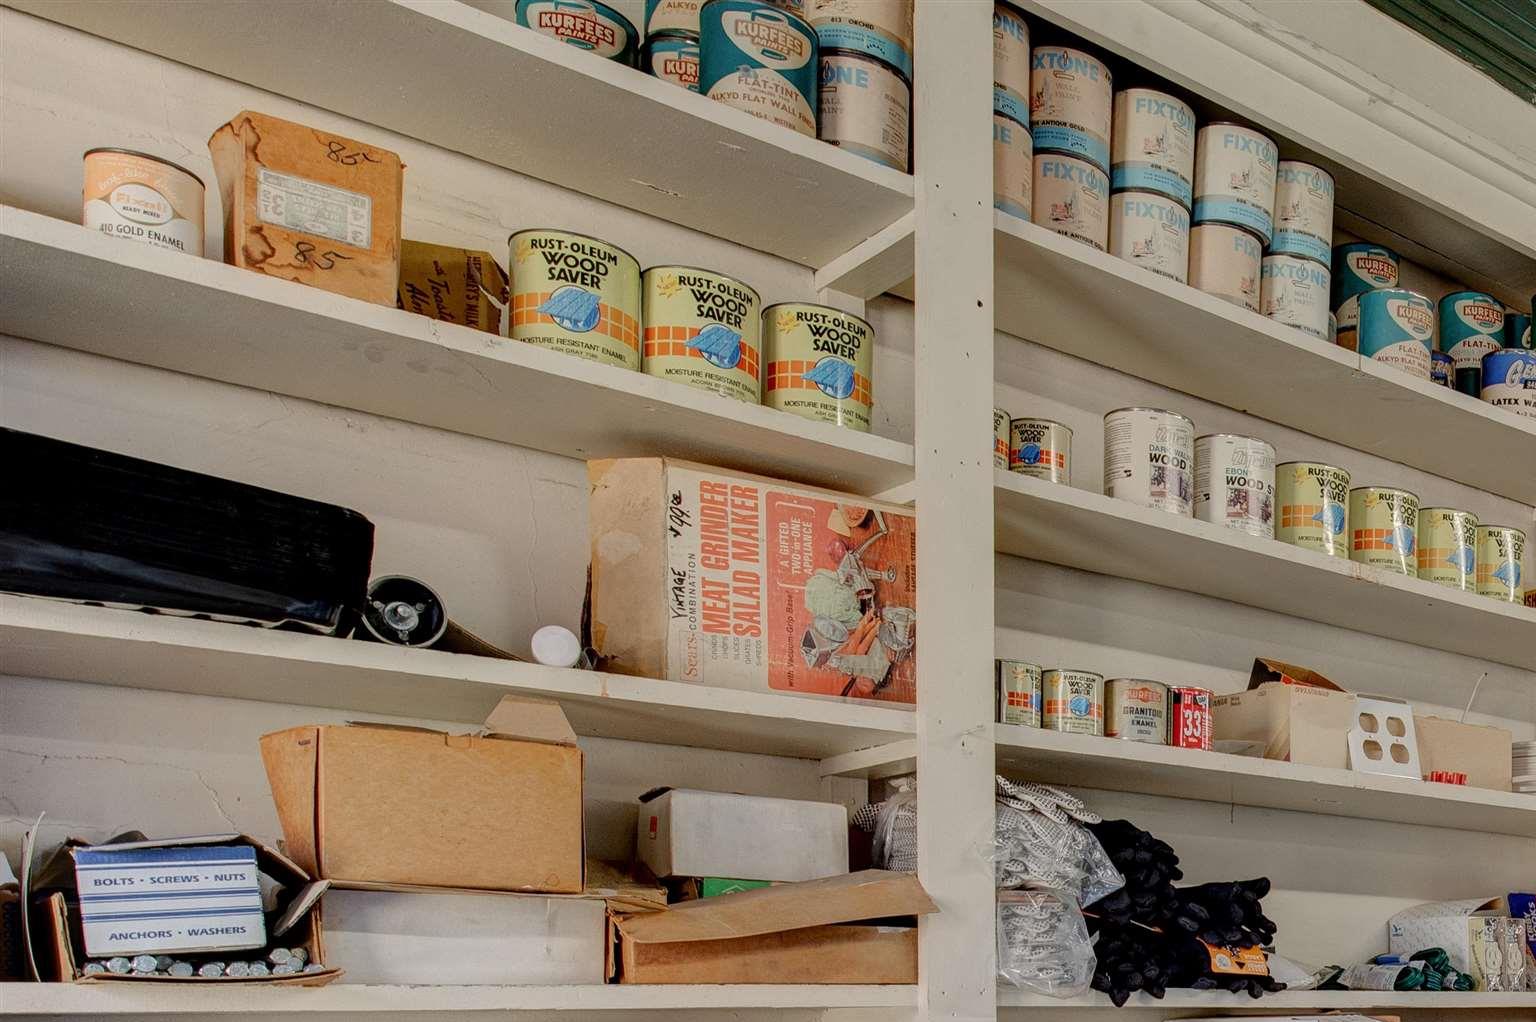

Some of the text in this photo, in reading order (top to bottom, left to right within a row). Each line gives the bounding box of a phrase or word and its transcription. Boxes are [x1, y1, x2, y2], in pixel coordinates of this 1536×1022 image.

[665, 1, 698, 11] ALKYD
[539, 11, 615, 47] KURFEES
[556, 27, 599, 44] PAINTS
[735, 19, 803, 56] KURFEES
[753, 36, 790, 54] PAINTS
[737, 76, 800, 101] FLAT-TINT
[711, 92, 739, 102] ALKYD
[742, 93, 767, 104] FLAT
[771, 100, 797, 118] WALL
[1124, 200, 1190, 236] FIXTON
[116, 223, 144, 236] GOLD
[147, 230, 185, 251] ENAMEL
[530, 238, 618, 267] RUST-OLEUM
[541, 250, 609, 277] WOOD
[547, 266, 602, 290] SAVER
[678, 275, 754, 307] RUST-OLEUM
[690, 288, 748, 318] WOOD
[696, 304, 743, 330] SAVER
[795, 311, 867, 340] RUST-OLEUM
[556, 337, 600, 352] RESISTANT
[808, 323, 861, 350] WOOD
[1462, 340, 1501, 350] FLAT-TIN
[813, 338, 857, 362] SAVER
[665, 368, 742, 389] MOISTURE RESISTANT
[784, 399, 819, 410] MOISTURE
[1491, 397, 1520, 406] LATEX
[1018, 429, 1045, 438] WOOD
[1020, 436, 1042, 444] SAVER
[1150, 452, 1187, 470] WOOD
[1225, 467, 1249, 476] EBON
[1225, 475, 1264, 491] WOOD
[778, 521, 789, 568] A GIFTED
[790, 516, 802, 576] TWO-in-ONE
[802, 520, 813, 576] APPLIANCE
[698, 480, 731, 636] MEAT GRINDER
[730, 485, 762, 638] SALAD MAKER
[670, 567, 688, 619] VINTAGE
[687, 552, 698, 631] COMBINATION
[784, 615, 796, 669] Vacuum-Grip
[683, 637, 698, 679] Sears
[785, 669, 795, 688] with
[1067, 680, 1094, 690] WOOD
[1183, 709, 1201, 738] 33
[93, 872, 247, 887] BOLTS SCREWS NUTS
[108, 925, 247, 942] ANCHORS WASHERS
